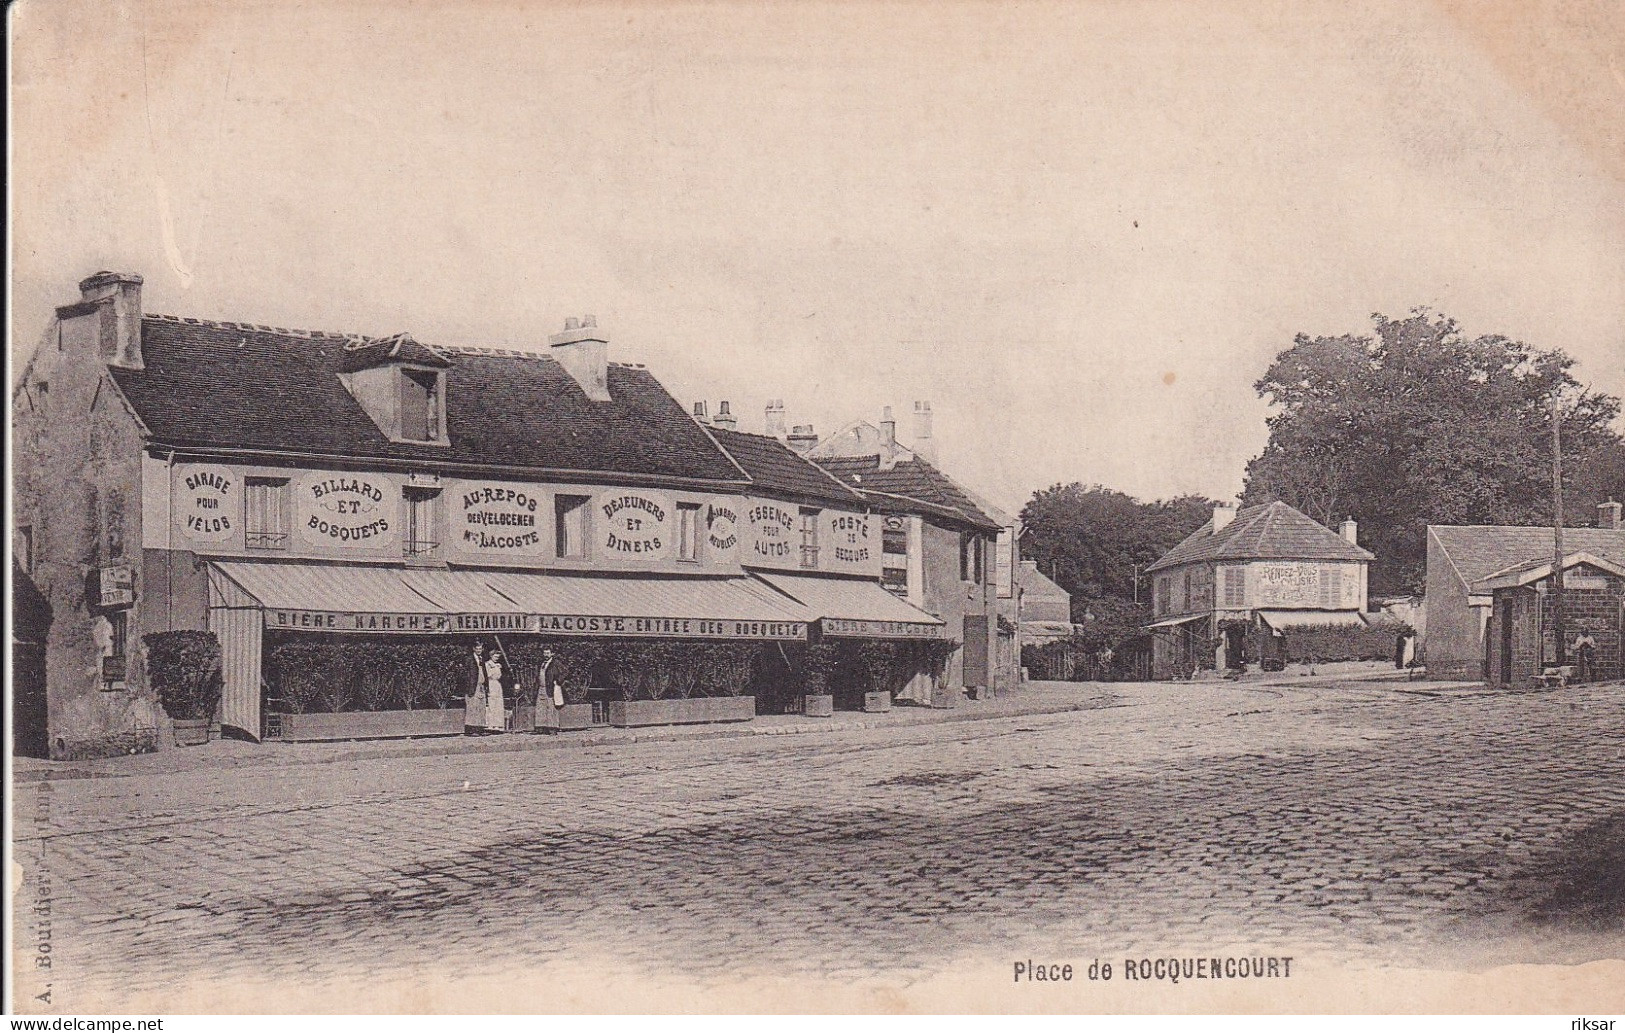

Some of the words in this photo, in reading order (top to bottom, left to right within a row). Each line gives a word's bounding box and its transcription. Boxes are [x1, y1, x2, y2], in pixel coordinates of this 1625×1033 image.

[185, 472, 231, 495] GARAGE
[312, 478, 383, 503] BILLARD
[196, 497, 219, 510] POUR
[337, 500, 361, 514] ET
[467, 512, 481, 524] DES
[626, 518, 642, 531] ET
[748, 505, 793, 531] ESSENCE
[308, 515, 389, 541] BOSQUETS
[831, 516, 869, 539] POSTE
[479, 531, 540, 548] LACOSTE
[606, 532, 662, 553] DINERS
[754, 540, 790, 556] AUTOS
[835, 547, 869, 562] SECOURS
[457, 616, 528, 629] RESTAURANT
[539, 617, 625, 631] LACOSTE
[700, 622, 723, 634] DES
[735, 622, 798, 637] BOSQUETS
